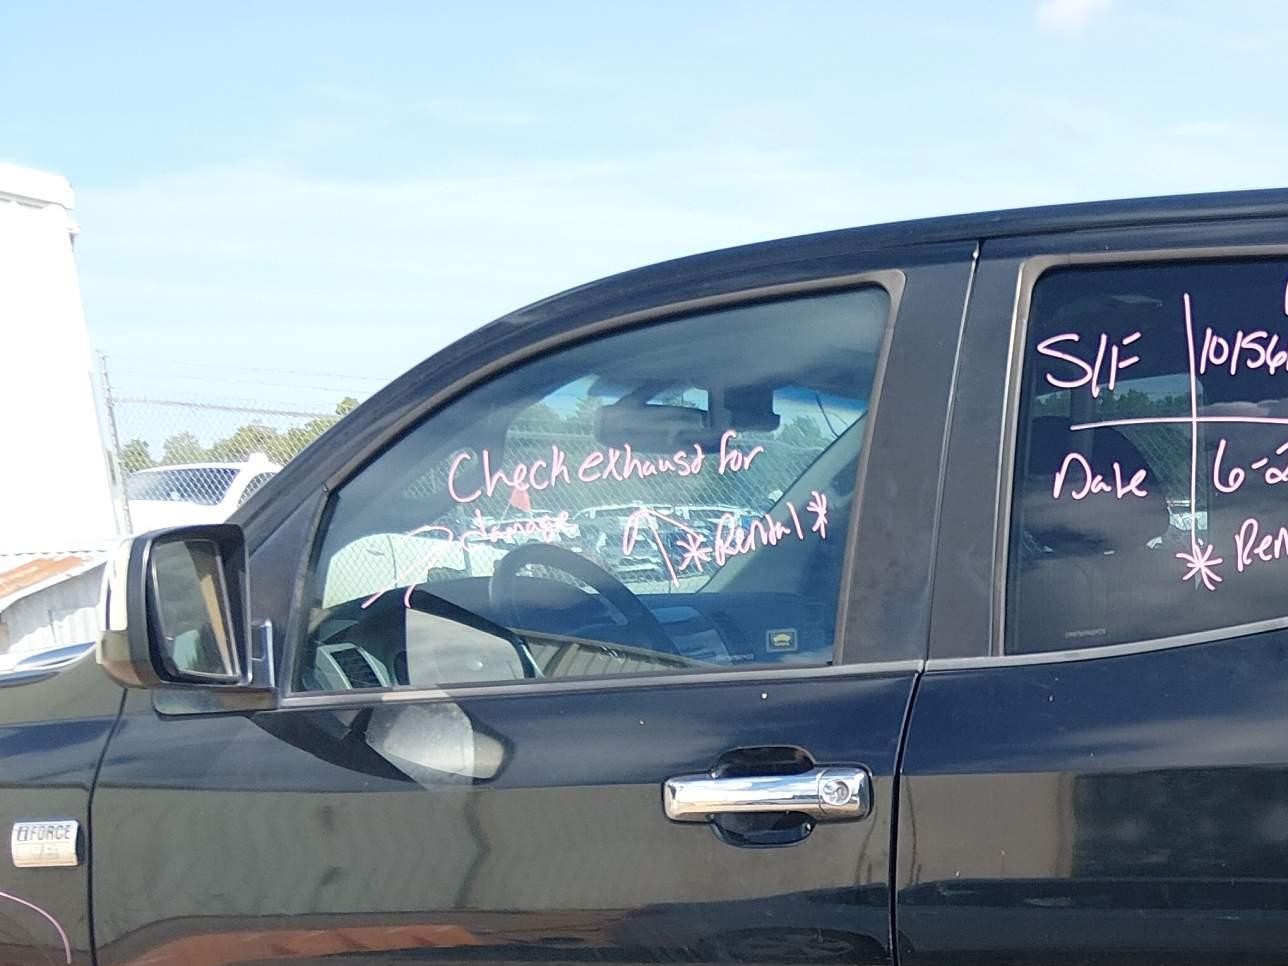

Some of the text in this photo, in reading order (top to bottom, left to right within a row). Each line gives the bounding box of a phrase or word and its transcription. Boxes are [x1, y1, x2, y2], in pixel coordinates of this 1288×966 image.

[447, 429, 764, 504] Check exhaust for
